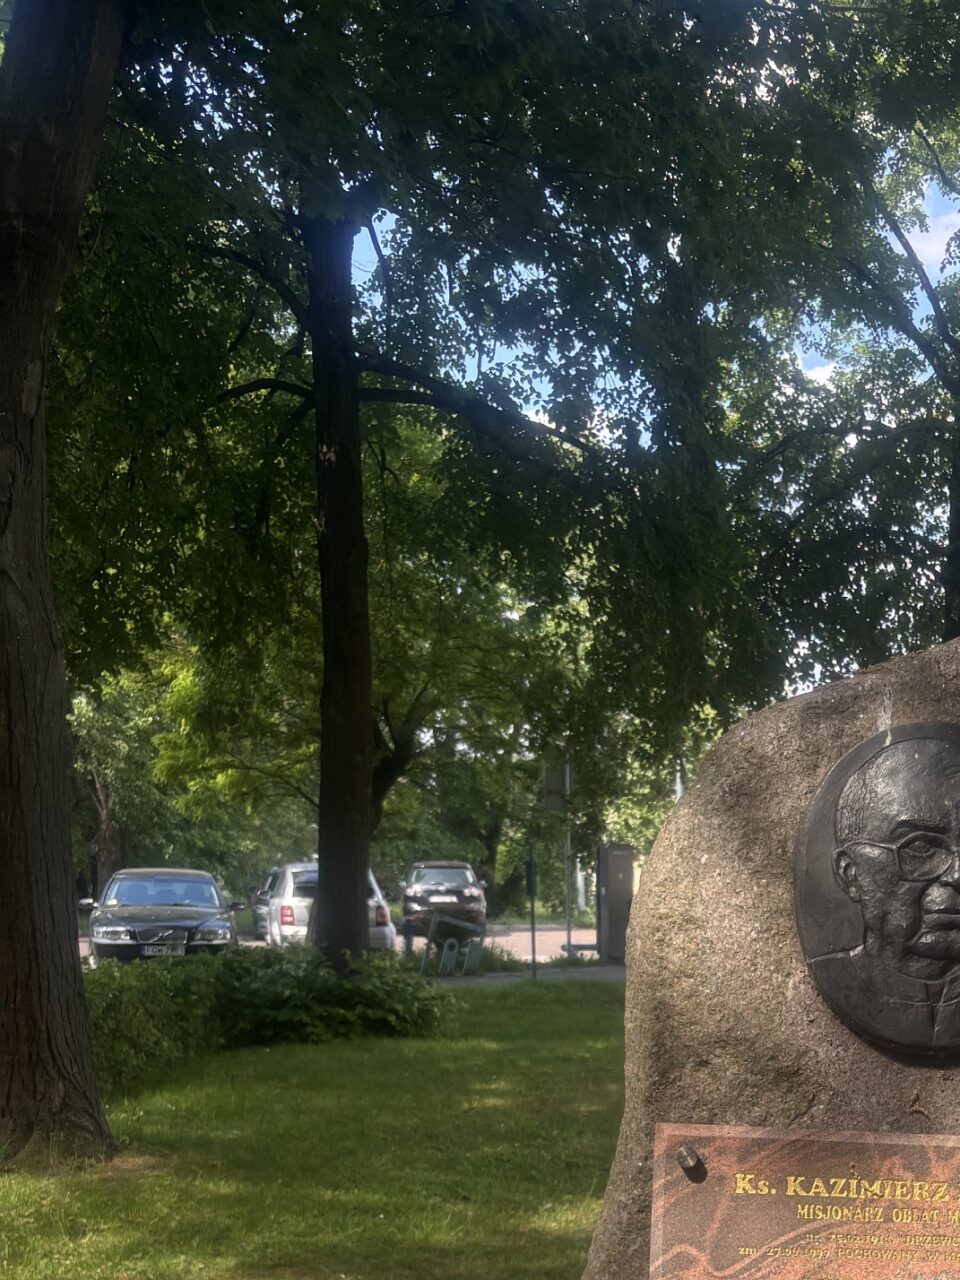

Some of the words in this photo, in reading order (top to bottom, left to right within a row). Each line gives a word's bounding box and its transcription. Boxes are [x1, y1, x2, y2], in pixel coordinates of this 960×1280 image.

[735, 1173, 776, 1195] Ks.
[786, 1176, 949, 1201] KAZIMIERZ
[797, 1204, 883, 1222] MISJONARZ
[892, 1208, 938, 1224] OBLAT
[838, 1248, 919, 1261] POCHOWANY
